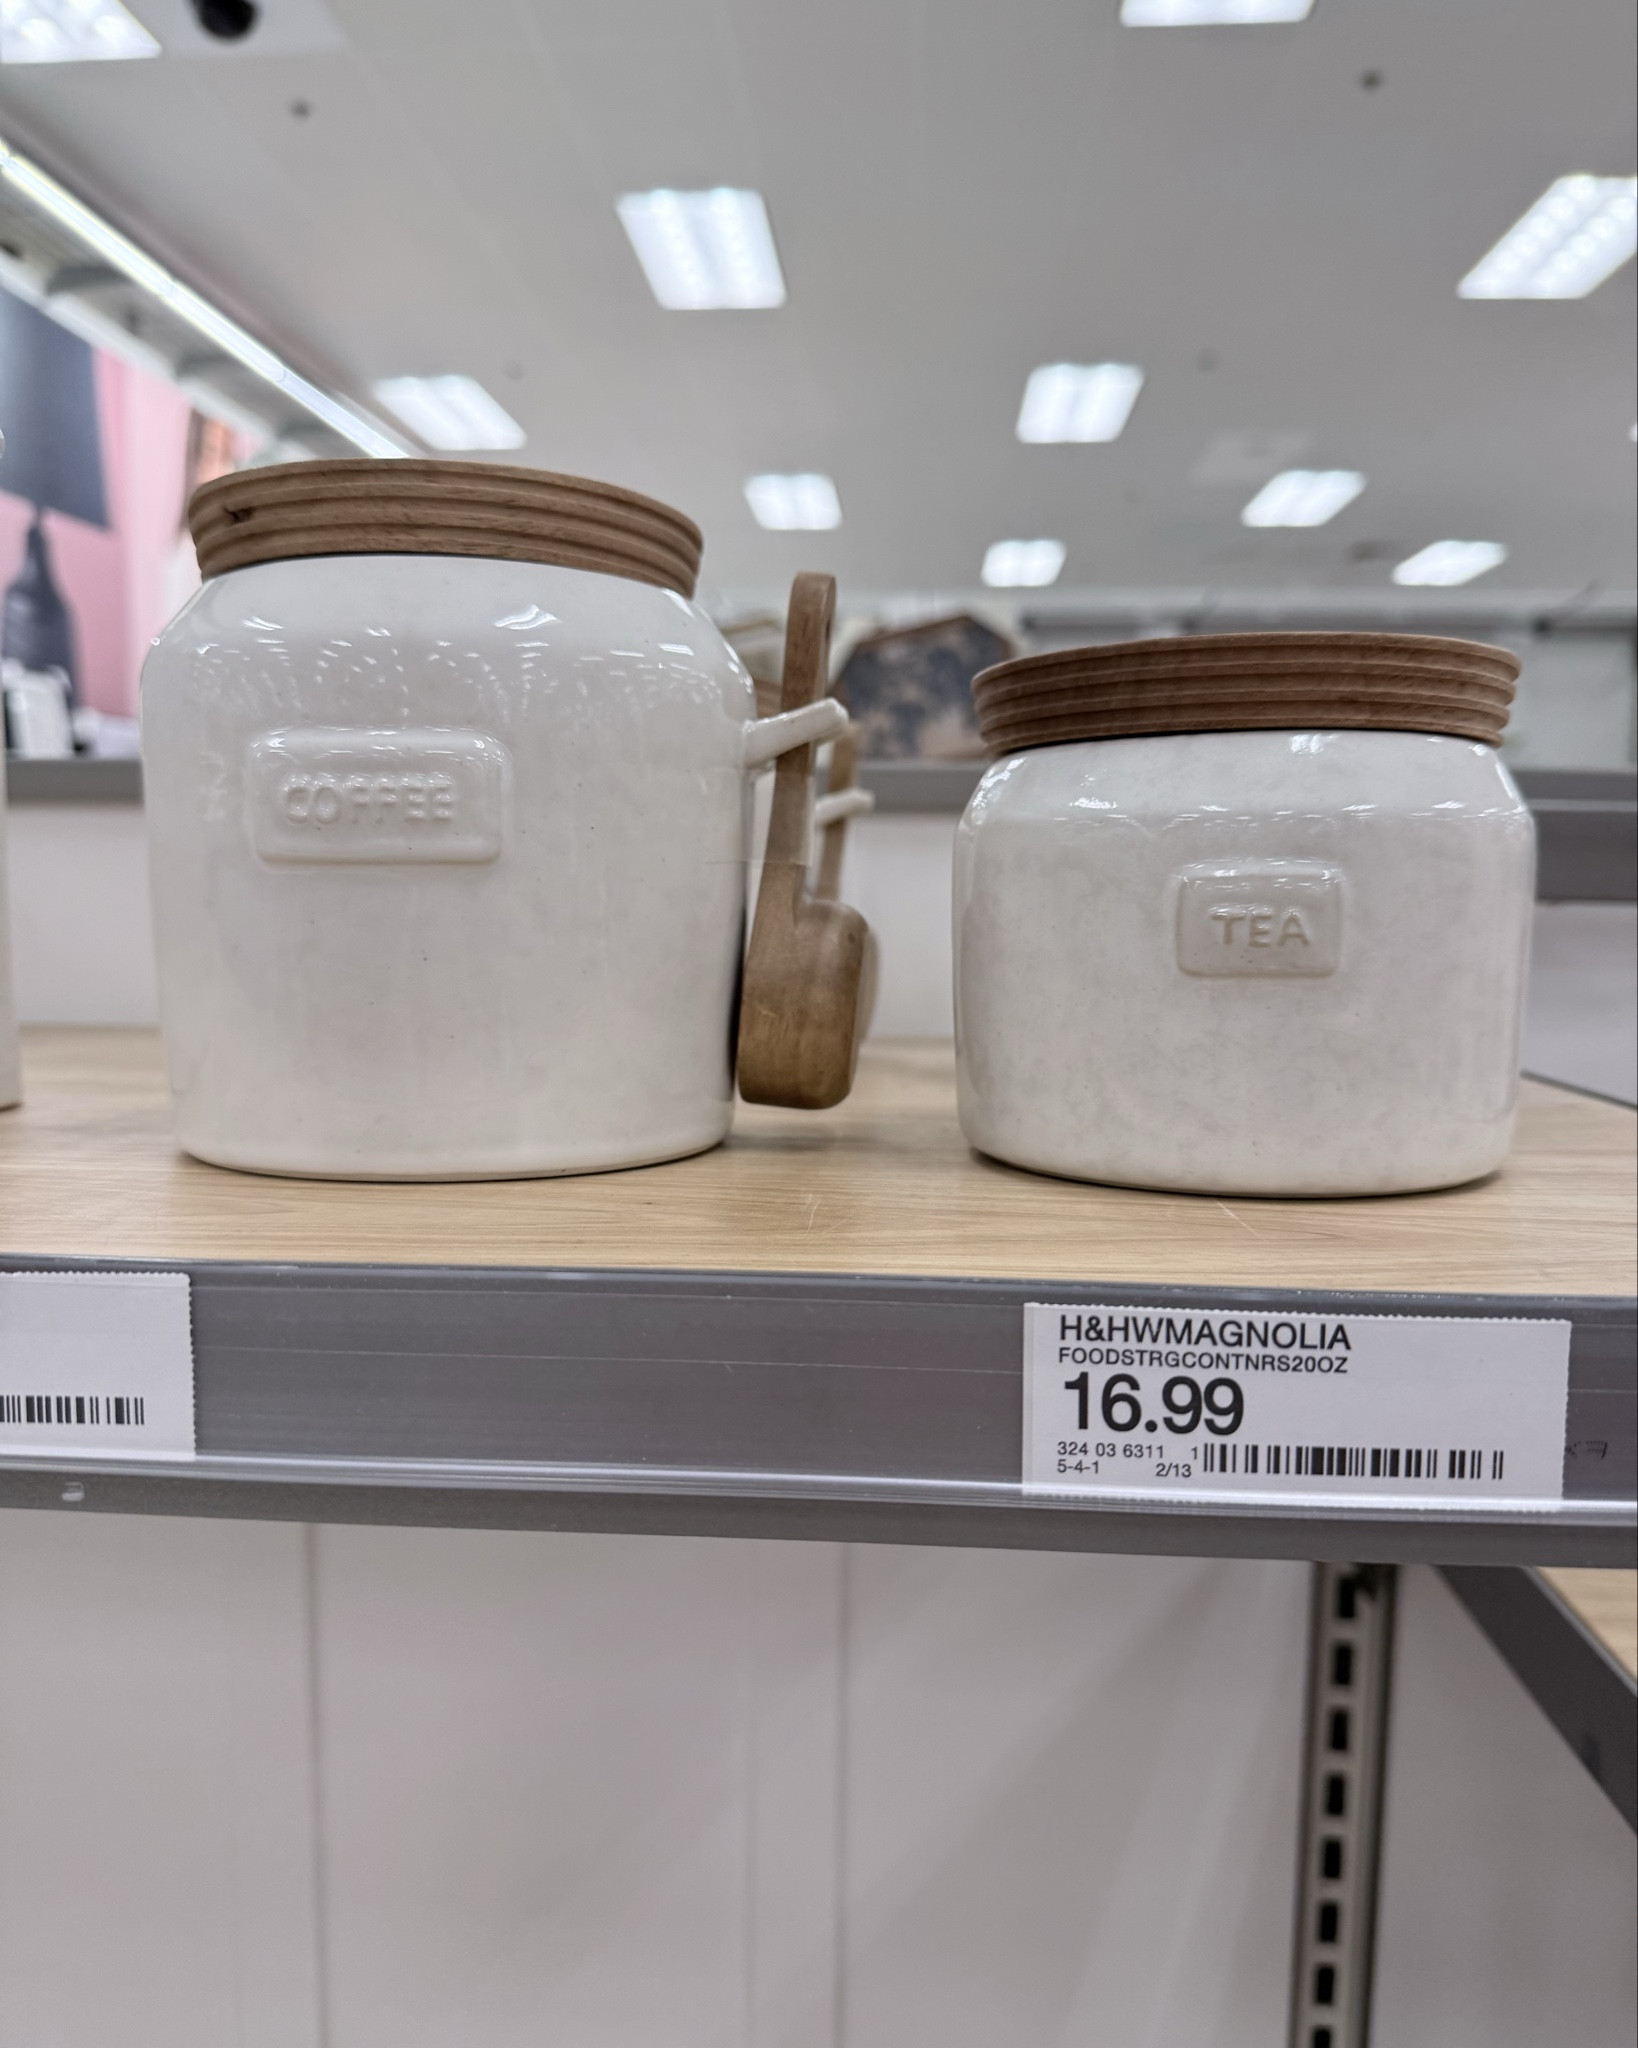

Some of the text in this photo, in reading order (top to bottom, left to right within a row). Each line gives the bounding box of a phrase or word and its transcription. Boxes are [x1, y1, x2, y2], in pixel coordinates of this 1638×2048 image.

[281, 771, 453, 825] COFFEE
[1208, 903, 1312, 948] TEA
[1059, 1314, 1352, 1350] H&HWMAGNOLIA
[1064, 1371, 1245, 1436] 16.99
[1056, 1458, 1193, 1479] 5-4-1 2/13
[1057, 1441, 1199, 1461] 324 03 6311 1
